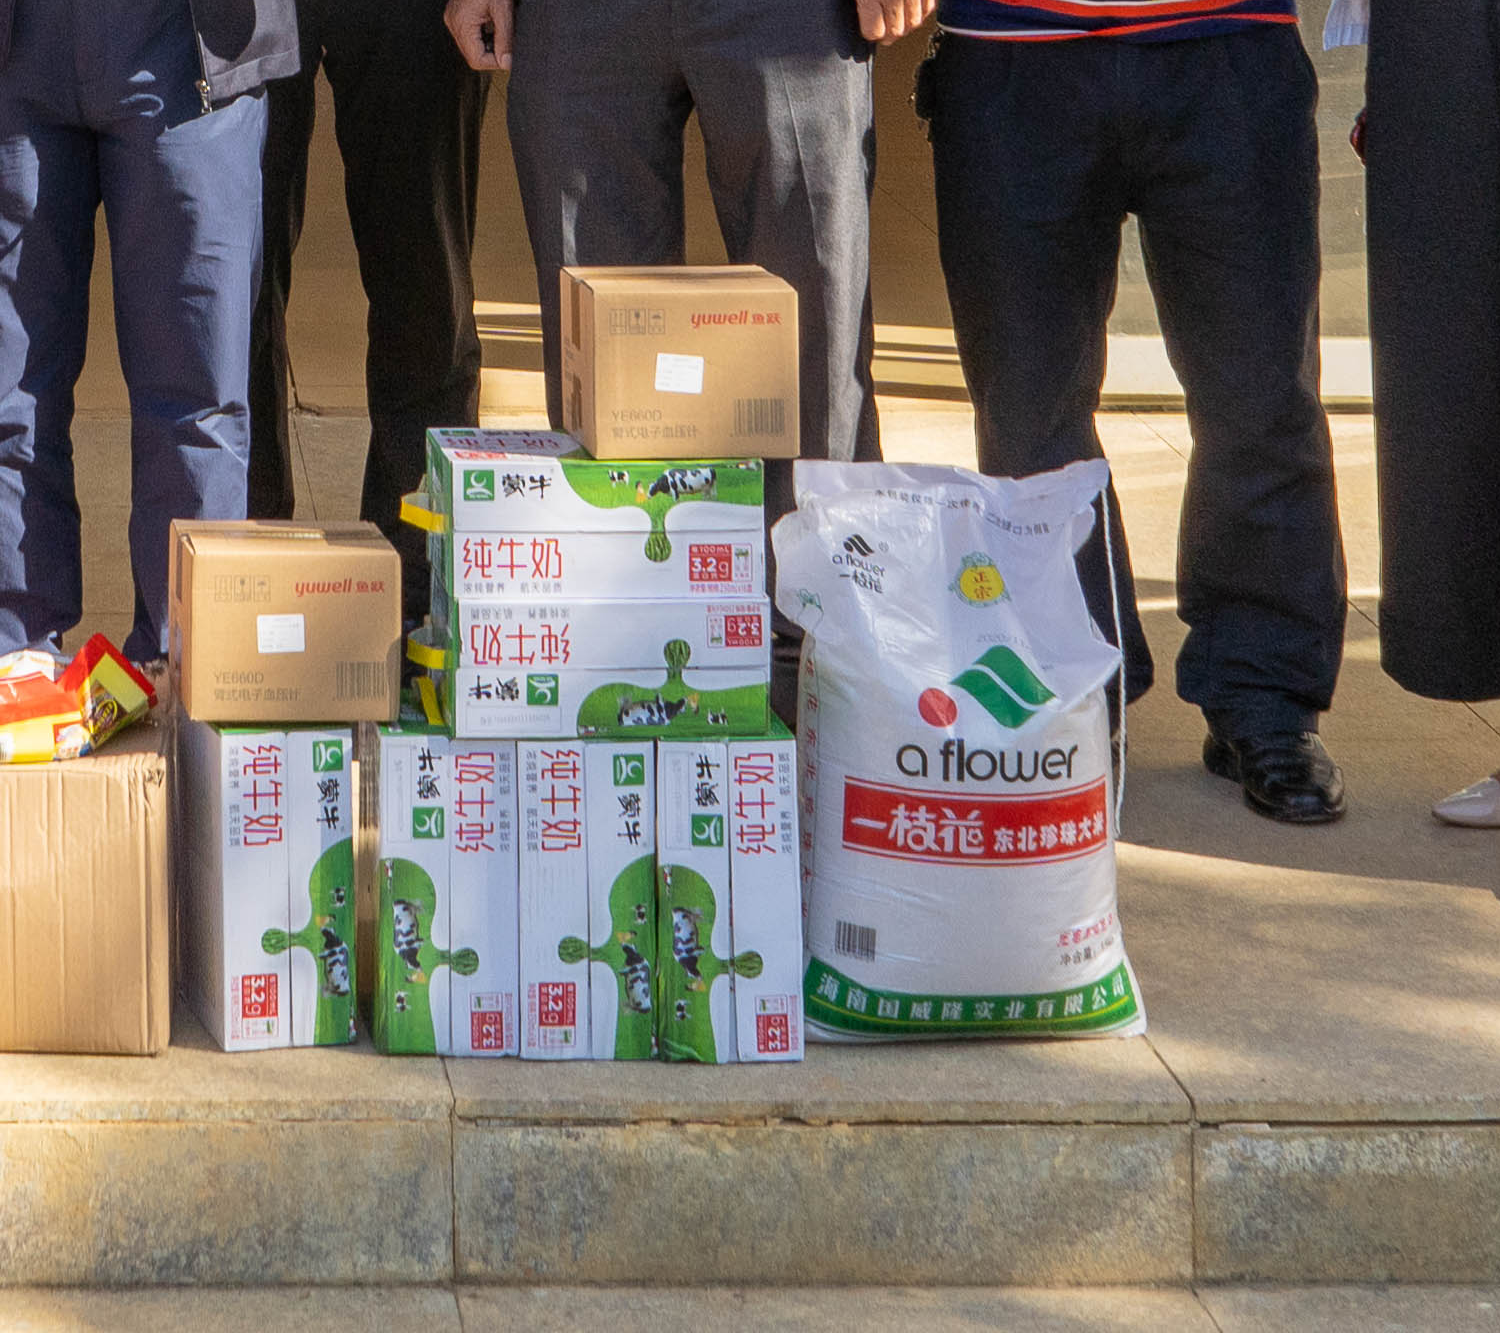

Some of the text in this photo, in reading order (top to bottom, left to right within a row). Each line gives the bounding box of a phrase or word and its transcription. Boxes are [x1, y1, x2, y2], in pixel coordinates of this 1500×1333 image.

[691, 310, 748, 329] yuwell
[502, 473, 552, 499] 蒙牛
[463, 537, 562, 580] 纯牛奶
[295, 578, 352, 597] yuwell
[470, 623, 570, 665] 纯牛奶
[896, 737, 1079, 783] a flower
[243, 744, 283, 847] 纯牛奶
[455, 752, 495, 853] 纯牛奶
[540, 749, 582, 852] 纯牛奶
[734, 753, 776, 854] 纯牛奶
[993, 811, 1105, 853] 东北珍珠大米
